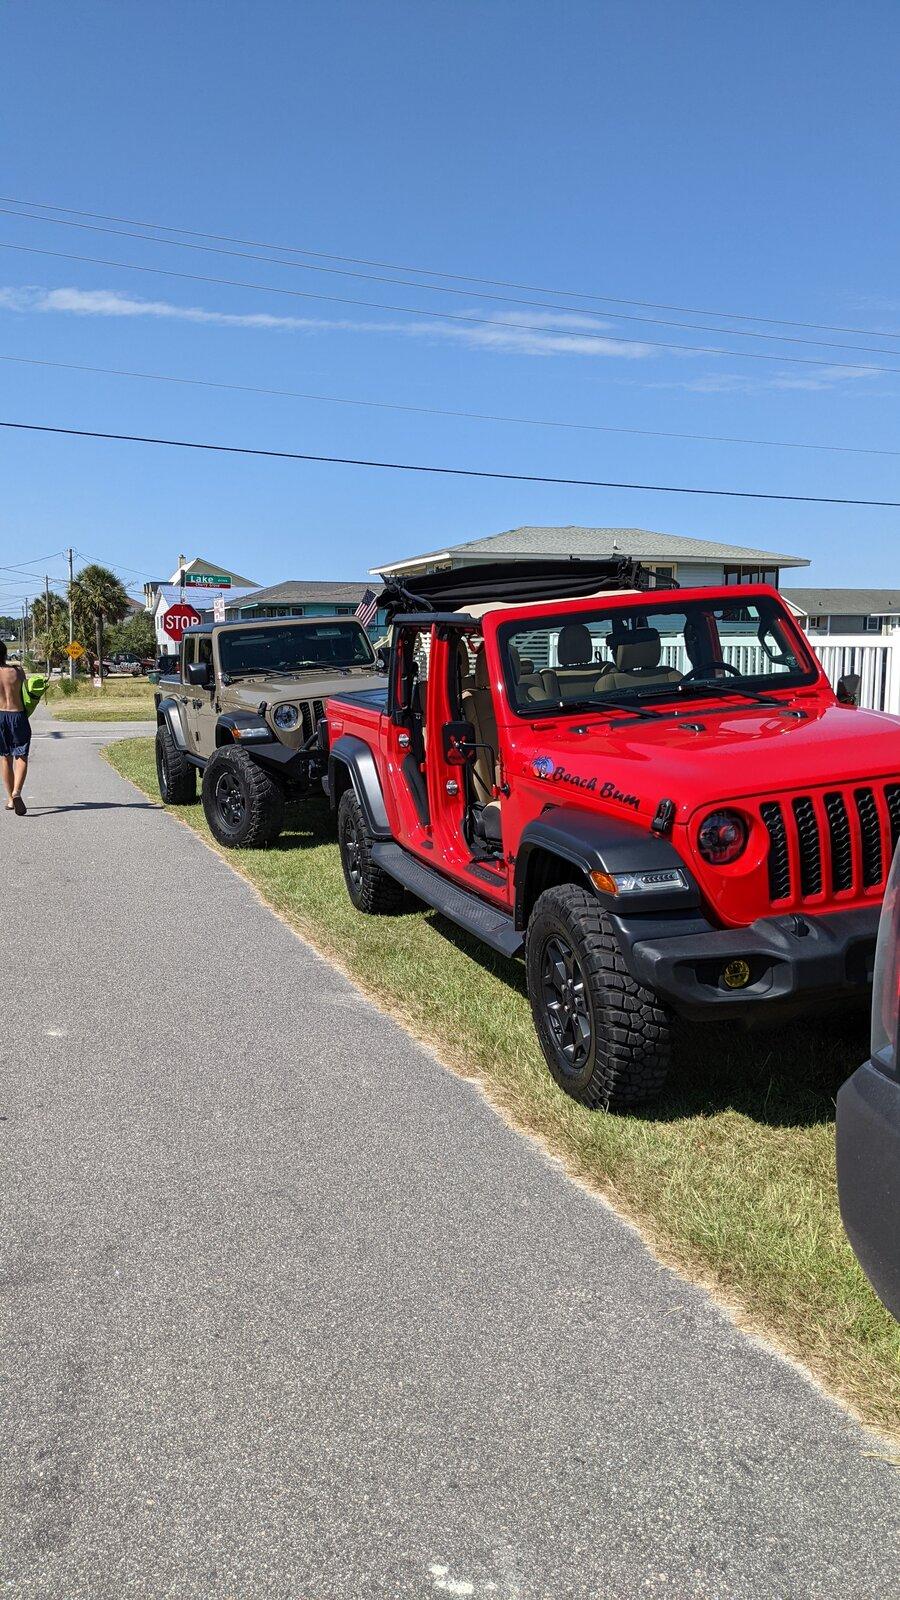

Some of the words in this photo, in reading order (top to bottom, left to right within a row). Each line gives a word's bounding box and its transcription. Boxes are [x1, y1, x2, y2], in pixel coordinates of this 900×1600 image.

[190, 575, 214, 584] Lake
[165, 615, 200, 630] STOP
[552, 766, 598, 791] Beach
[599, 782, 641, 809] Bum
